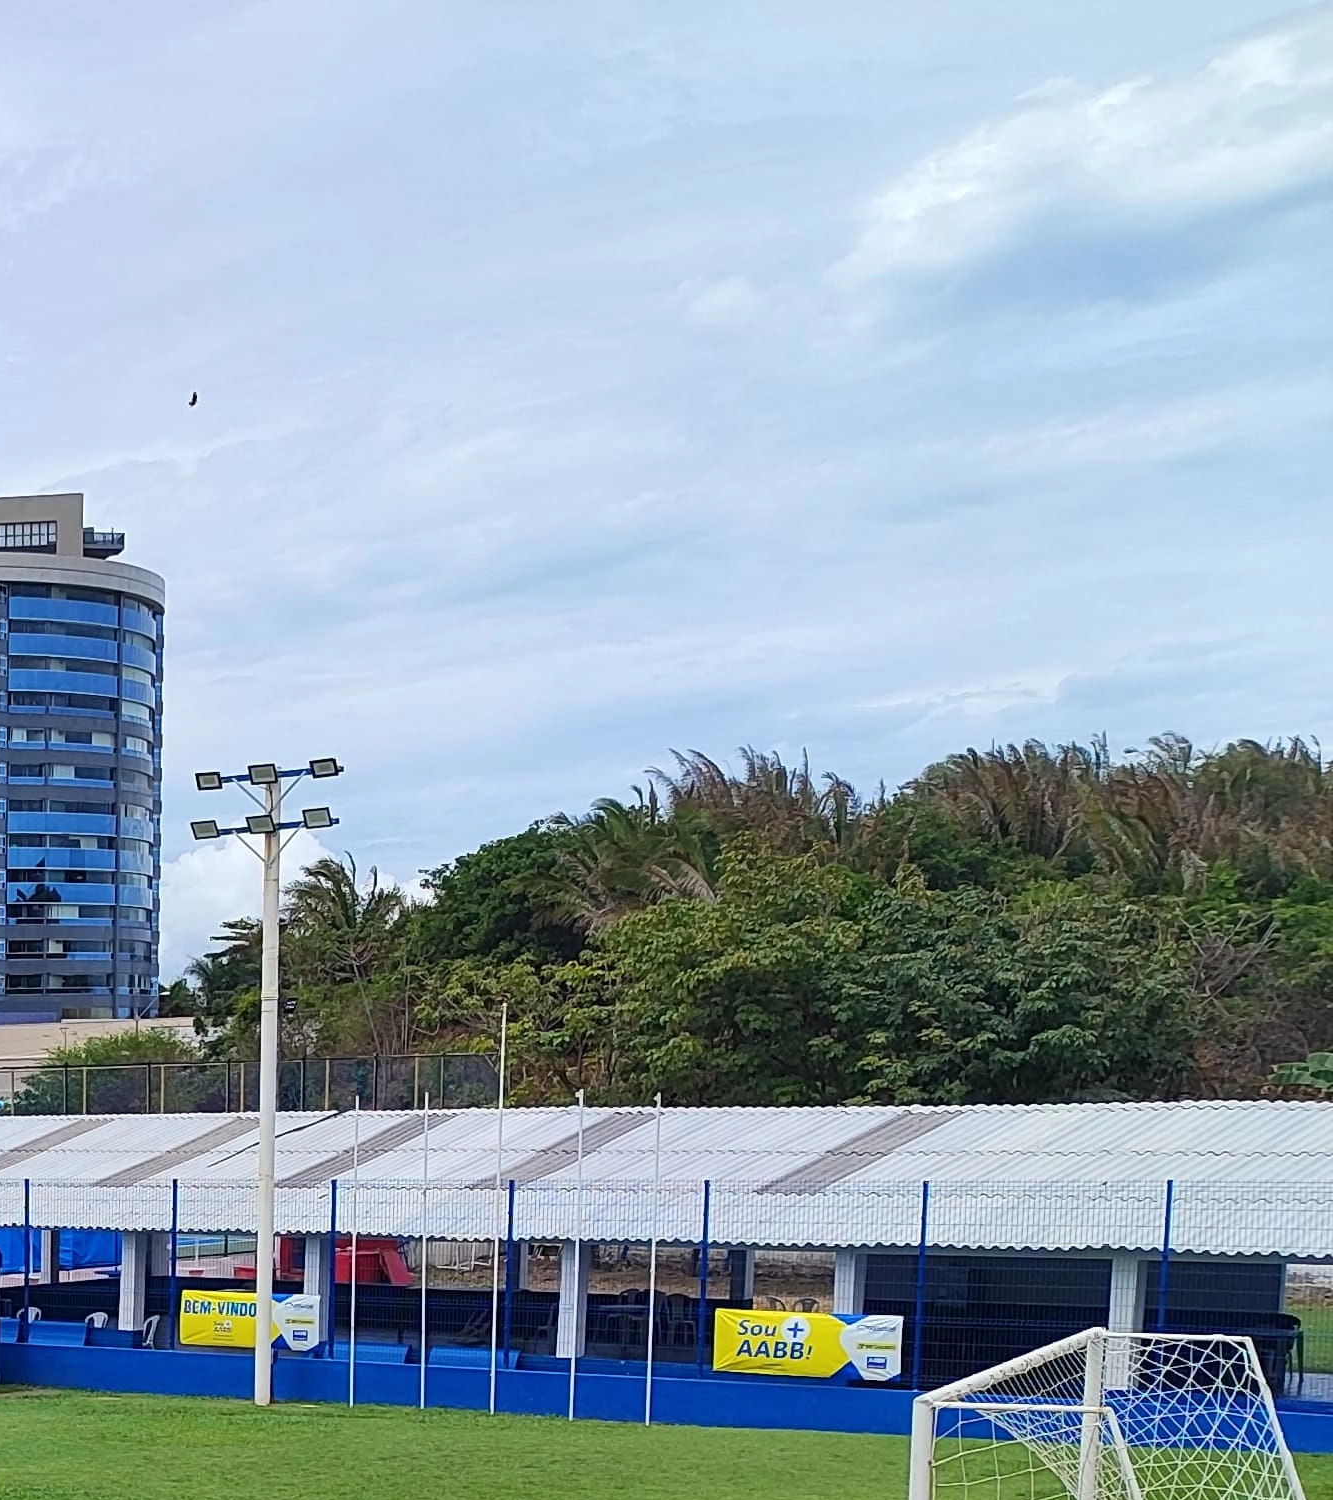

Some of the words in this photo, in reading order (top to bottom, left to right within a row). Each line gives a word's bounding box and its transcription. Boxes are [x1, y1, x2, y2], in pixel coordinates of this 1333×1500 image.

[184, 1299, 257, 1317] BEM-VINDO
[737, 1319, 777, 1337] Sou
[736, 1339, 813, 1361] AABB!
